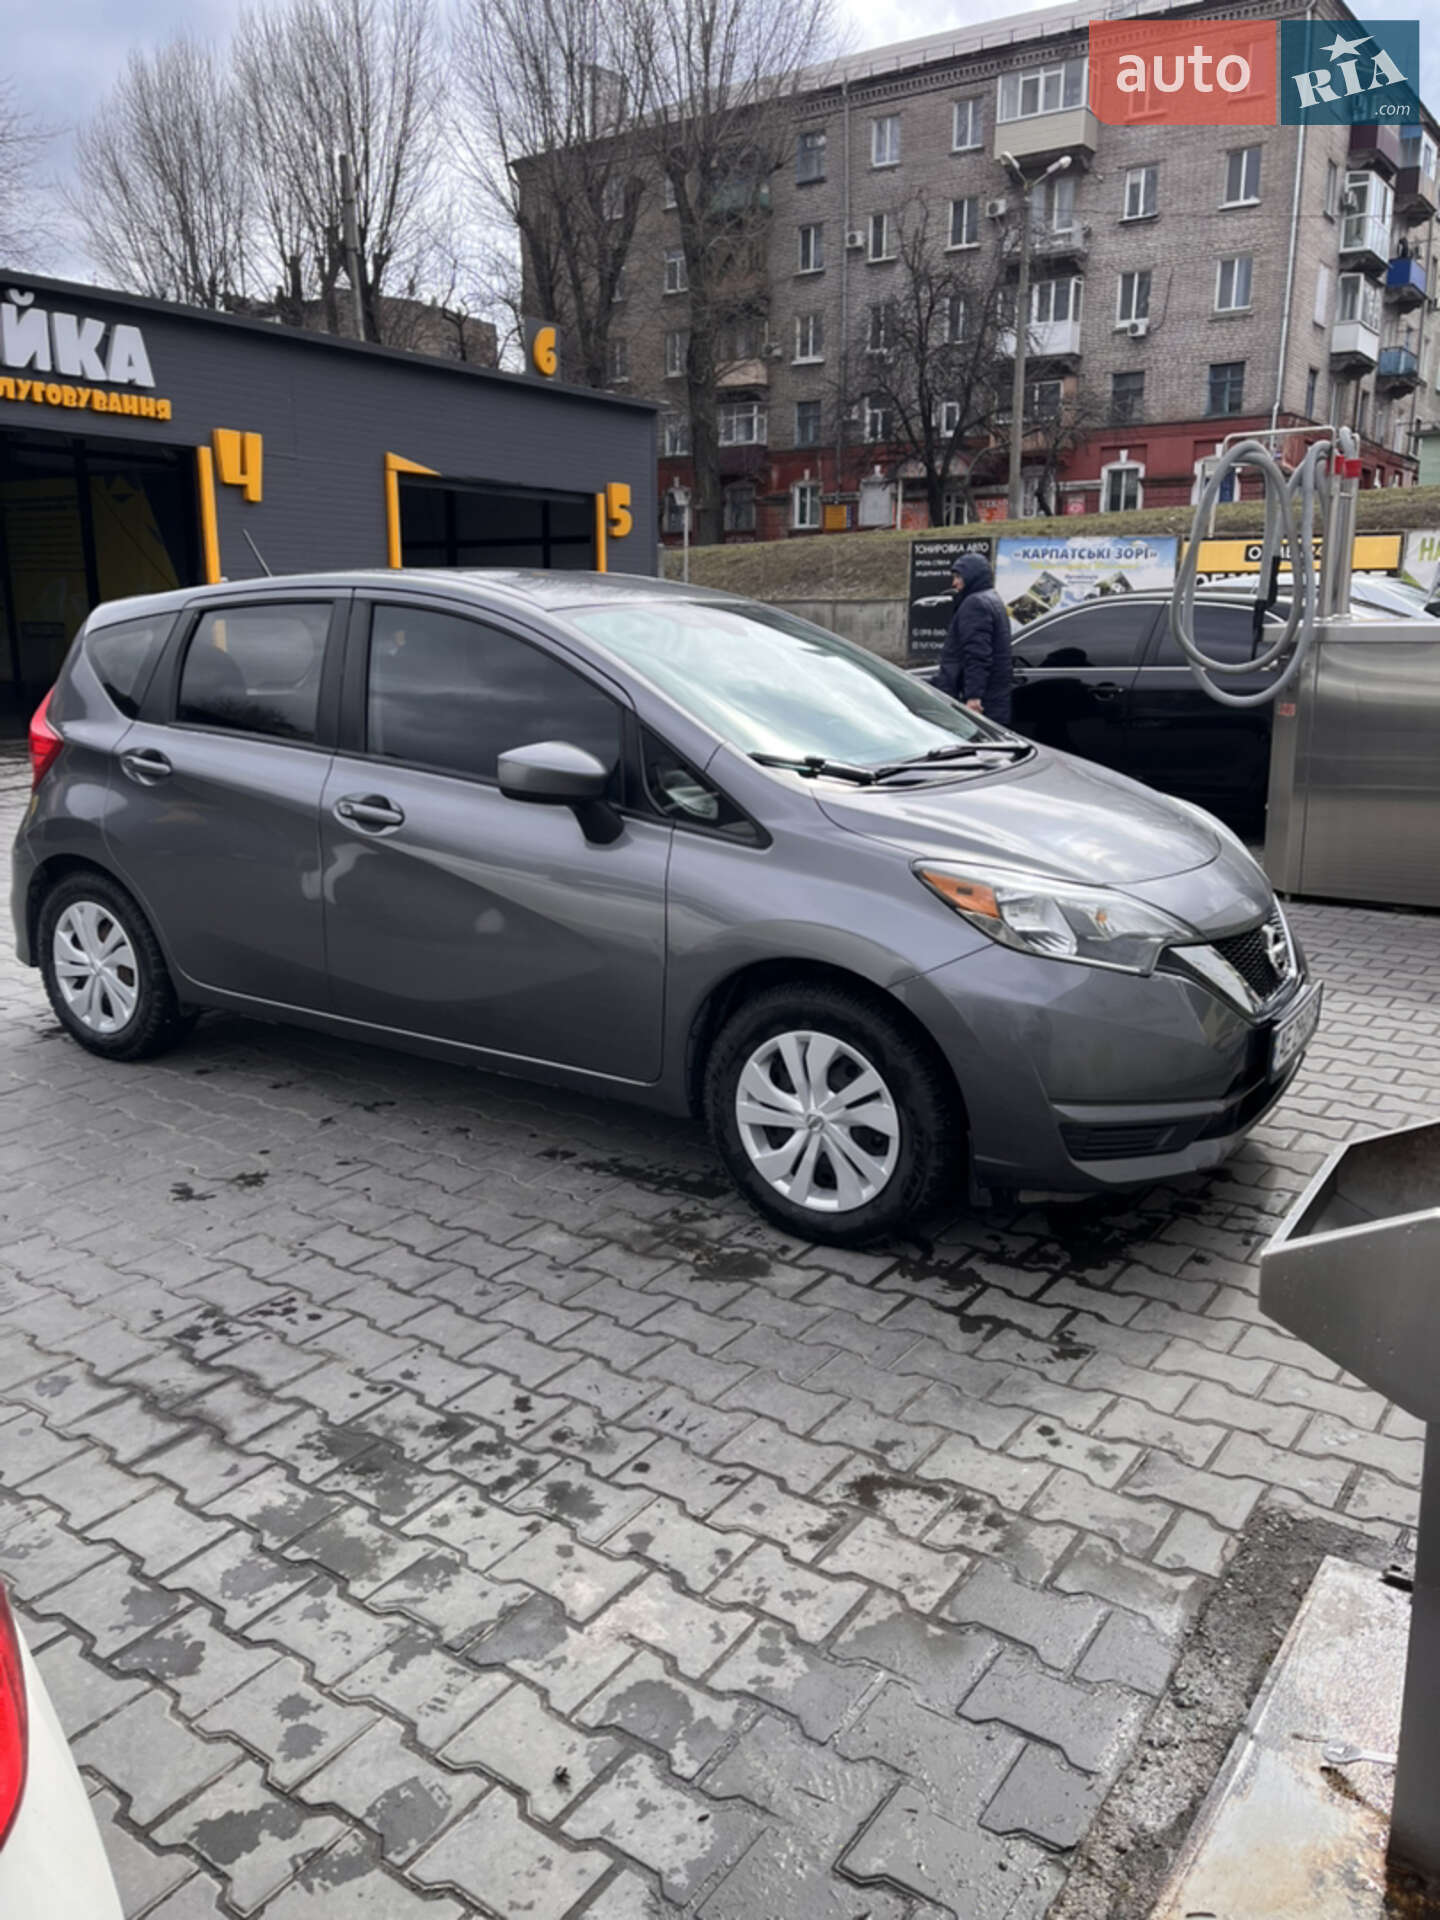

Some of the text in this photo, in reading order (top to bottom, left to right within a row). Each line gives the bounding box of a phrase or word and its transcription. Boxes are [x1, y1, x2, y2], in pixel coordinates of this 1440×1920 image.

[0, 288, 156, 388] ЙКА
[533, 326, 558, 377] 6
[607, 482, 633, 538] 5
